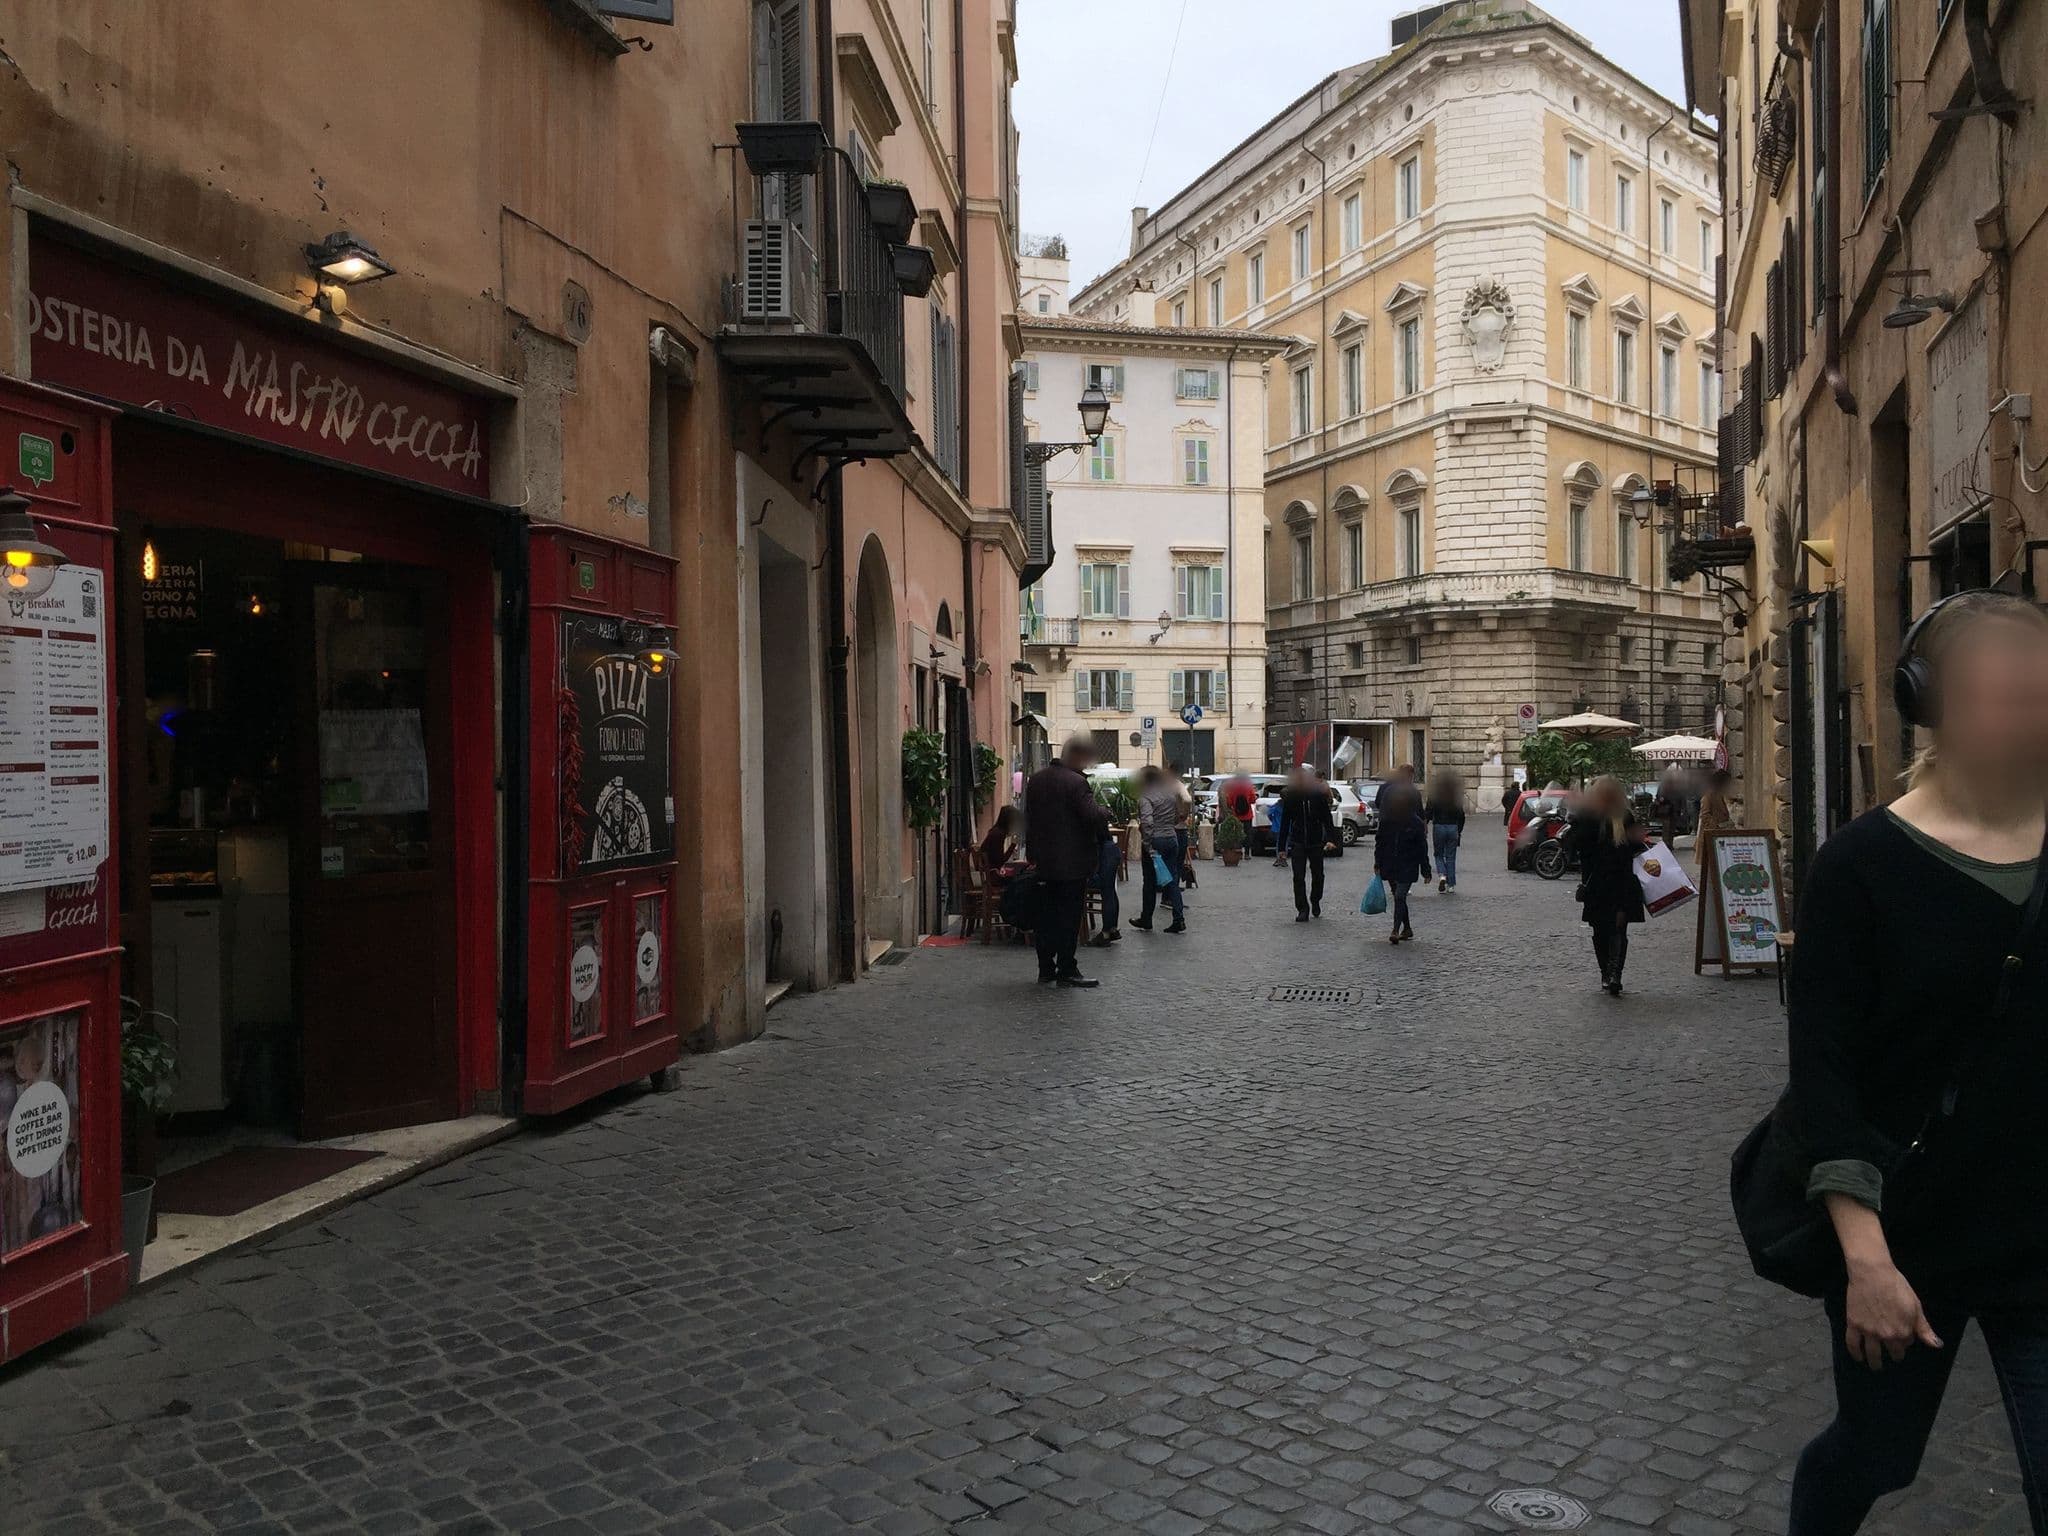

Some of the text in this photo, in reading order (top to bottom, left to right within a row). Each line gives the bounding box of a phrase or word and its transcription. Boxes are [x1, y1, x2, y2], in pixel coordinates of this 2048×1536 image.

[166, 334, 210, 386] DA
[223, 340, 365, 446] MASTRO
[366, 401, 482, 480] CICCIA
[1956, 393, 1962, 434] E
[28, 598, 66, 608] Breakfast
[595, 661, 648, 717] PIZZA
[599, 727, 620, 752] FORNO
[621, 729, 628, 752] A
[75, 844, 97, 862] 12,00
[49, 899, 98, 929] CICCIA
[574, 963, 593, 974] HAPPY
[575, 973, 593, 985] HOUR
[20, 1101, 57, 1120] WINE BAR
[15, 1112, 62, 1134] COFFEE BAR
[15, 1123, 63, 1147] SOFT DRINKS
[16, 1136, 62, 1159] APPETIZERS
